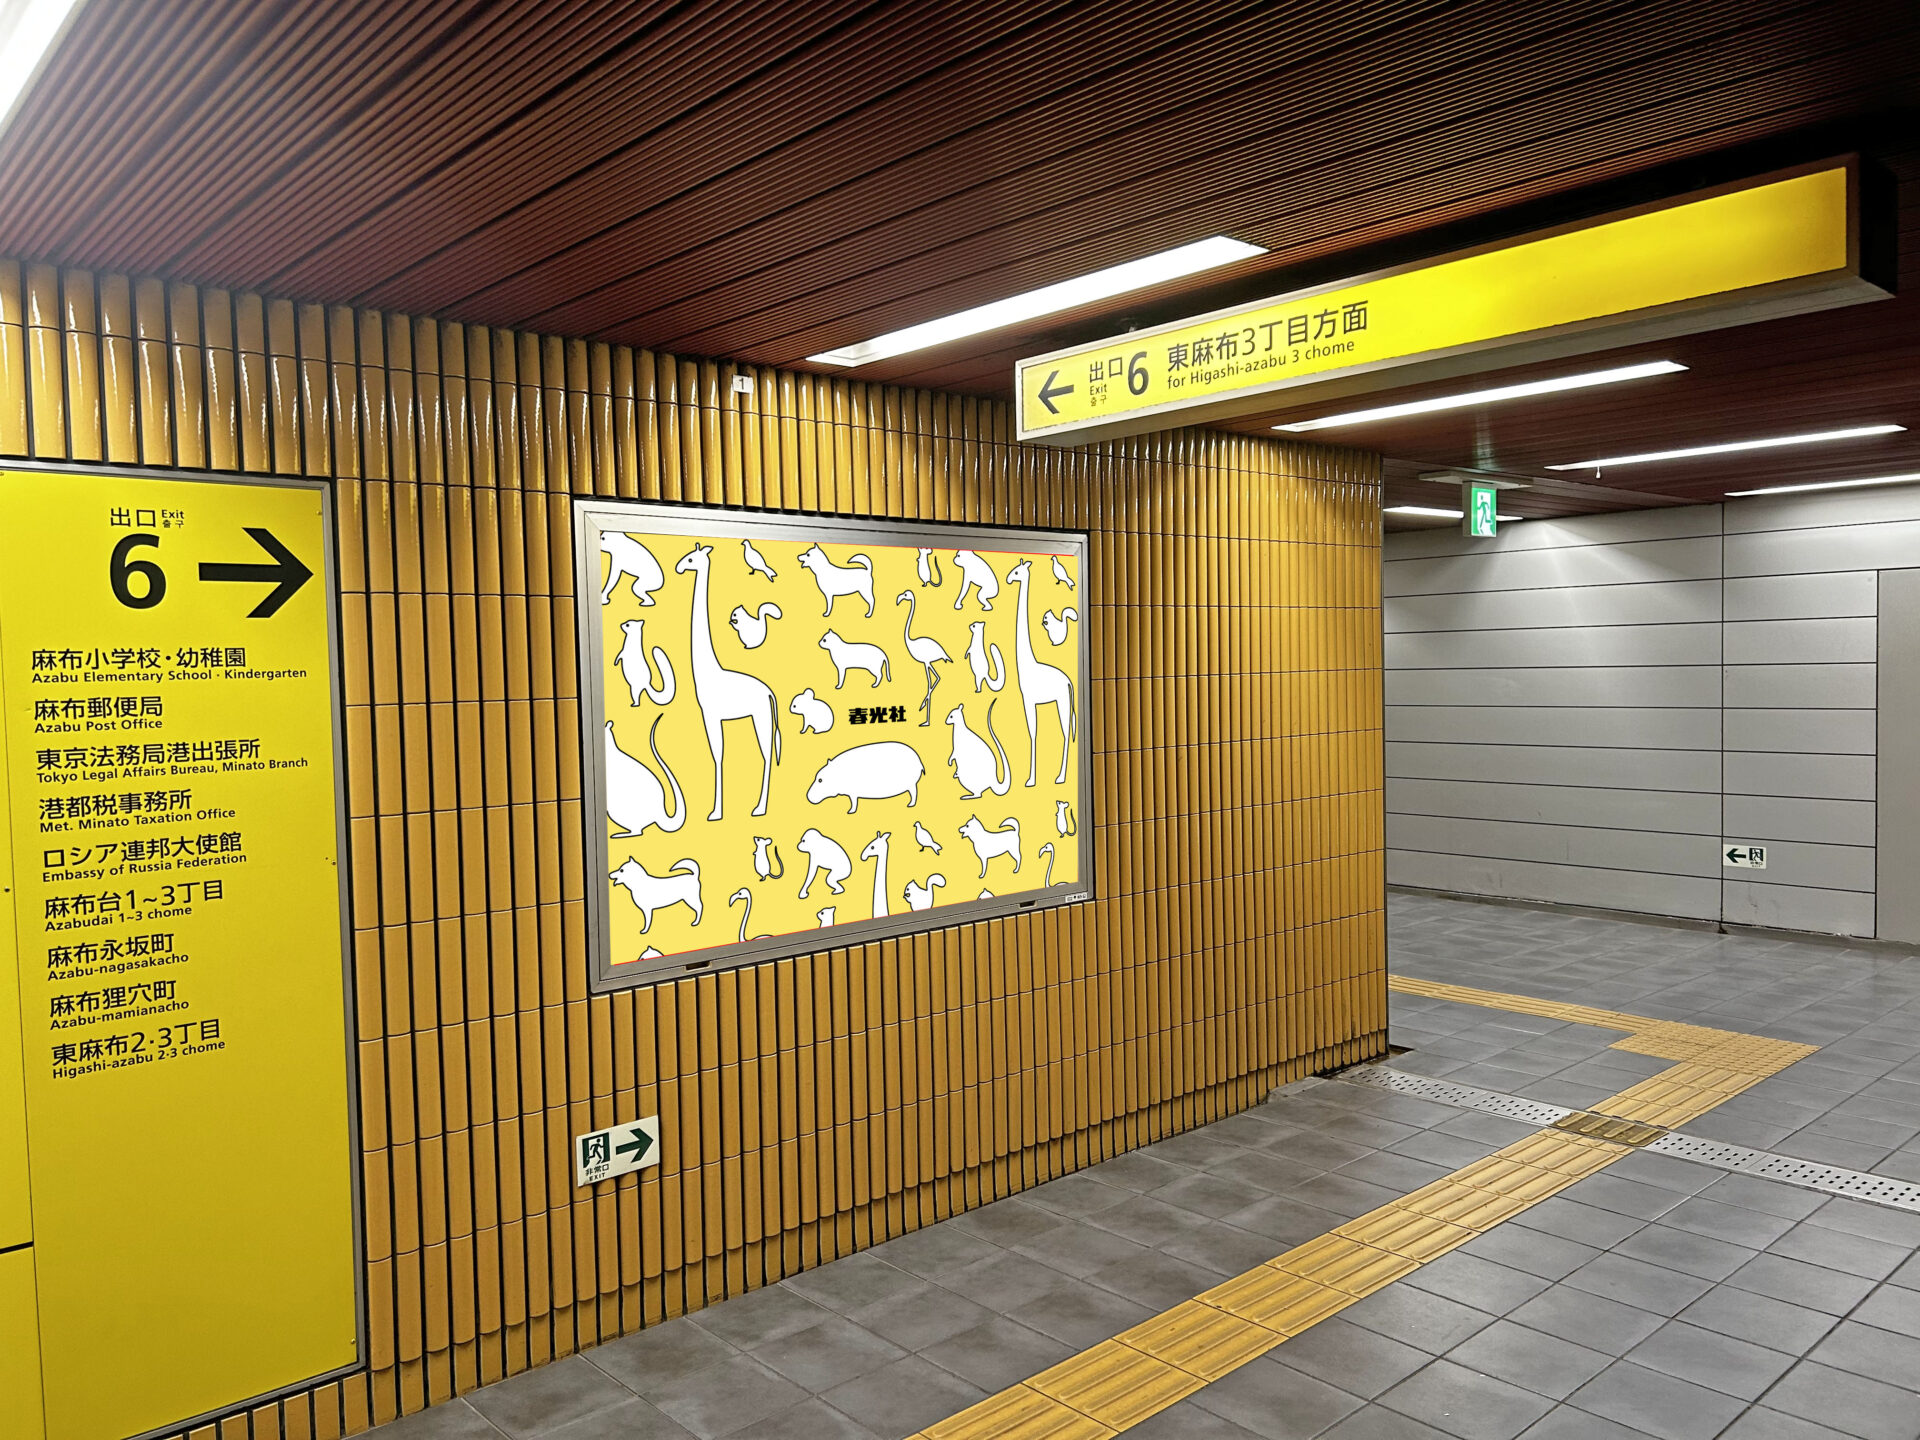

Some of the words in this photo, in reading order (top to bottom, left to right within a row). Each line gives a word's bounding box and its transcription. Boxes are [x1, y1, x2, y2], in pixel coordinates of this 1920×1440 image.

[1167, 300, 1369, 373] 東麻布3丁目方面
[1089, 356, 1123, 383] 出口
[1128, 351, 1149, 396] 6
[1167, 375, 1187, 389] for
[1190, 354, 1287, 384] Higashi-azabu
[1292, 348, 1300, 363] 3
[1304, 340, 1355, 361] chome
[1089, 383, 1107, 396] Exit
[110, 506, 157, 528] 出口
[161, 509, 185, 520] Exit
[110, 533, 167, 609] 6
[31, 647, 247, 671] 麻布小学校・幼稚園
[31, 671, 79, 684] Azabu
[83, 670, 164, 684] Elementary
[167, 669, 213, 681] School
[224, 667, 308, 681] Kindergarten
[33, 696, 164, 721] 麻布郵便局
[848, 705, 908, 726] 春光社
[34, 722, 82, 734] Azabu
[85, 721, 117, 732] Post
[120, 718, 164, 730] Office
[36, 738, 260, 770] 東京法務局港出張所
[36, 770, 79, 785] Tokyo
[82, 768, 119, 783] Legal
[122, 764, 167, 778] Affairs
[170, 762, 219, 776] Bureau,
[222, 760, 266, 773] Minato
[269, 756, 309, 770] Branch
[39, 789, 192, 819] 港都税事務所
[40, 822, 74, 833] Met.
[78, 816, 131, 830] Minato
[134, 811, 193, 827] Taxation
[196, 807, 237, 821] Office
[43, 831, 242, 867] ロシア連邦大使館
[42, 866, 106, 883] Embassy
[110, 863, 125, 876] of
[128, 860, 173, 875] Russia
[176, 852, 248, 870] Federation
[45, 914, 113, 932] Azabudai
[147, 905, 193, 920] chome
[47, 933, 174, 969] 麻布永坂町
[47, 953, 189, 982] Azabu-nagasakacho
[50, 980, 177, 1018] 麻布狸穴町
[50, 1000, 189, 1030] Azabu-mamianacho
[53, 1053, 154, 1080] Higashi-azabu
[182, 1040, 226, 1056] chome
[586, 1163, 609, 1176] 非常口
[589, 1172, 605, 1181] EXIT
